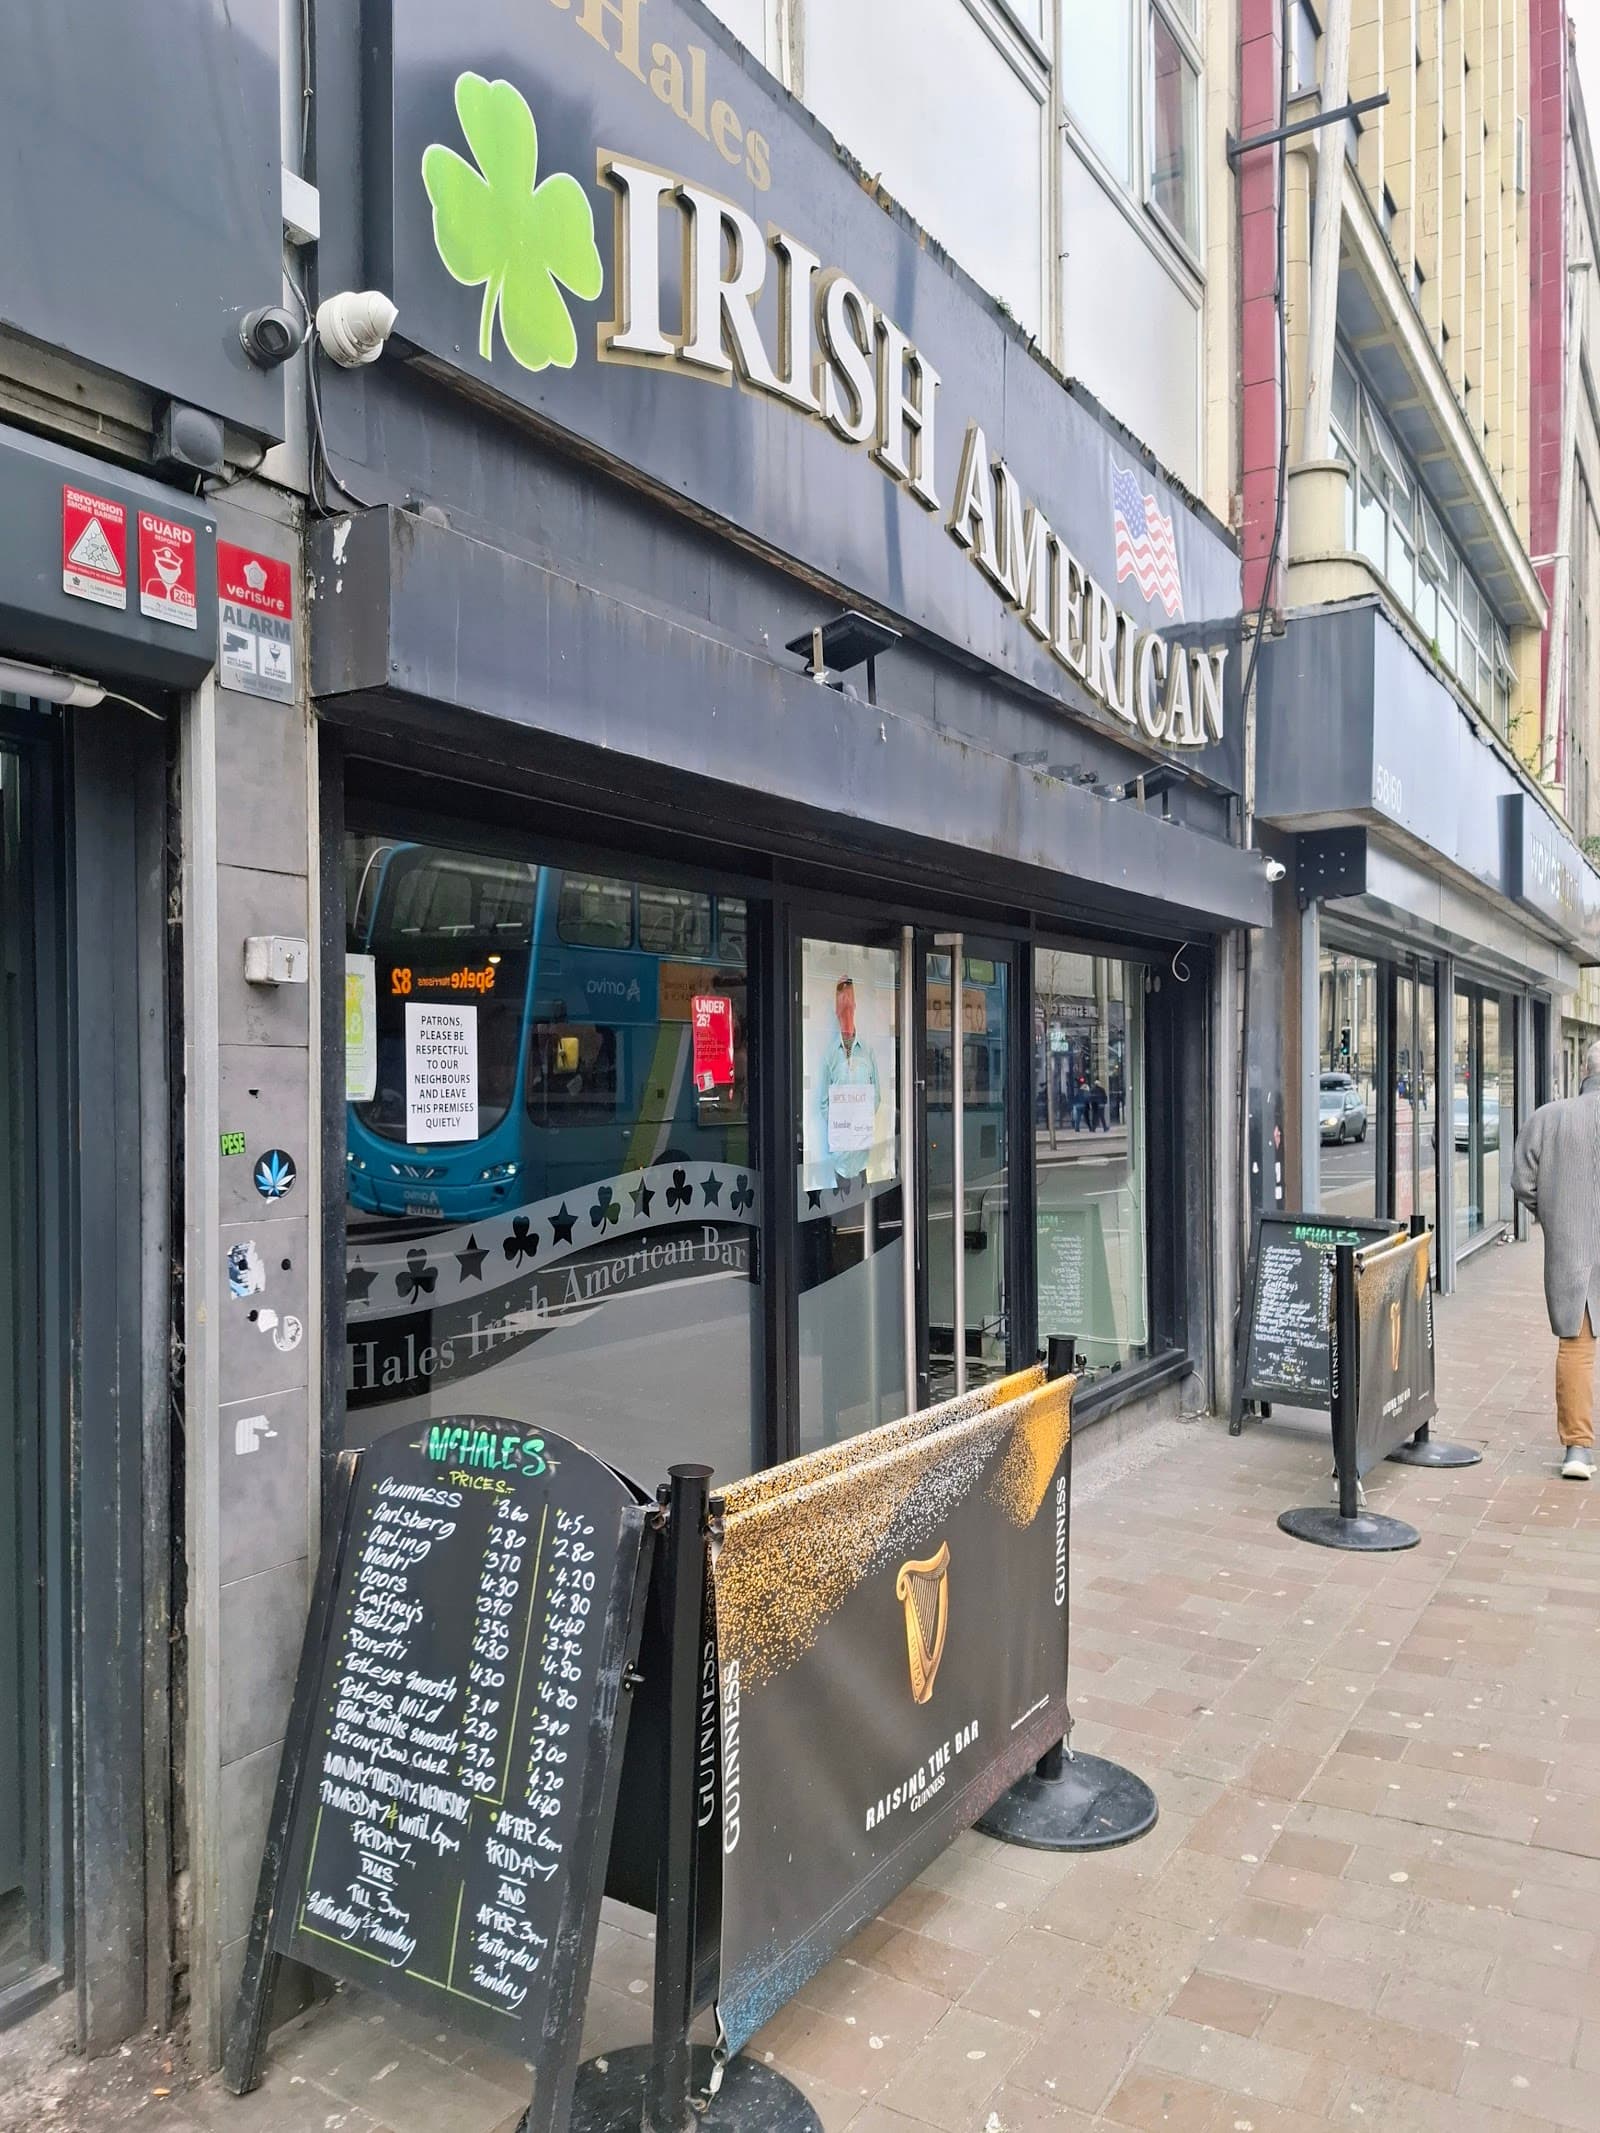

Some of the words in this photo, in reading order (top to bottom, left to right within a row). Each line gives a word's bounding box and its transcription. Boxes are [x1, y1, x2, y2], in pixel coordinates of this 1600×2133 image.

[547, 0, 771, 191] Hales
[601, 155, 942, 511] IRISH
[945, 424, 1229, 745] AMERICAN
[142, 517, 192, 543] GUARD
[174, 590, 195, 605] 24H
[226, 583, 285, 611] verisure
[223, 605, 291, 641] ALARM
[695, 1000, 724, 1013] UNDER
[421, 1016, 463, 1027] PATRONS,
[696, 1014, 711, 1027] 25?
[420, 1030, 452, 1040] PLEASE
[453, 1031, 464, 1040] BE
[416, 1045, 468, 1055] RESPECTFUL
[427, 1060, 439, 1069] TO
[440, 1060, 458, 1069] OUR
[414, 1074, 470, 1084] NEIGHBOURS
[419, 1089, 438, 1099] AND
[440, 1089, 466, 1098] LEAVE
[412, 1104, 431, 1113] THIS
[433, 1103, 474, 1113] PREMISES
[425, 1117, 461, 1128] QUIETLY
[345, 1333, 455, 1390] Hales
[467, 1285, 548, 1359] Irish
[560, 1237, 695, 1314] American
[701, 1225, 746, 1268] Bar
[1055, 1476, 1067, 1606] GUINNESS
[724, 1659, 741, 1854] GUINNESS
[866, 1766, 926, 1832] RAISING
[928, 1741, 951, 1778] THE
[955, 1720, 979, 1755] BAR
[910, 1771, 946, 1813] GUINNESS
[485, 1837, 559, 1882] FRIDAY
[498, 1882, 526, 1906] AND
